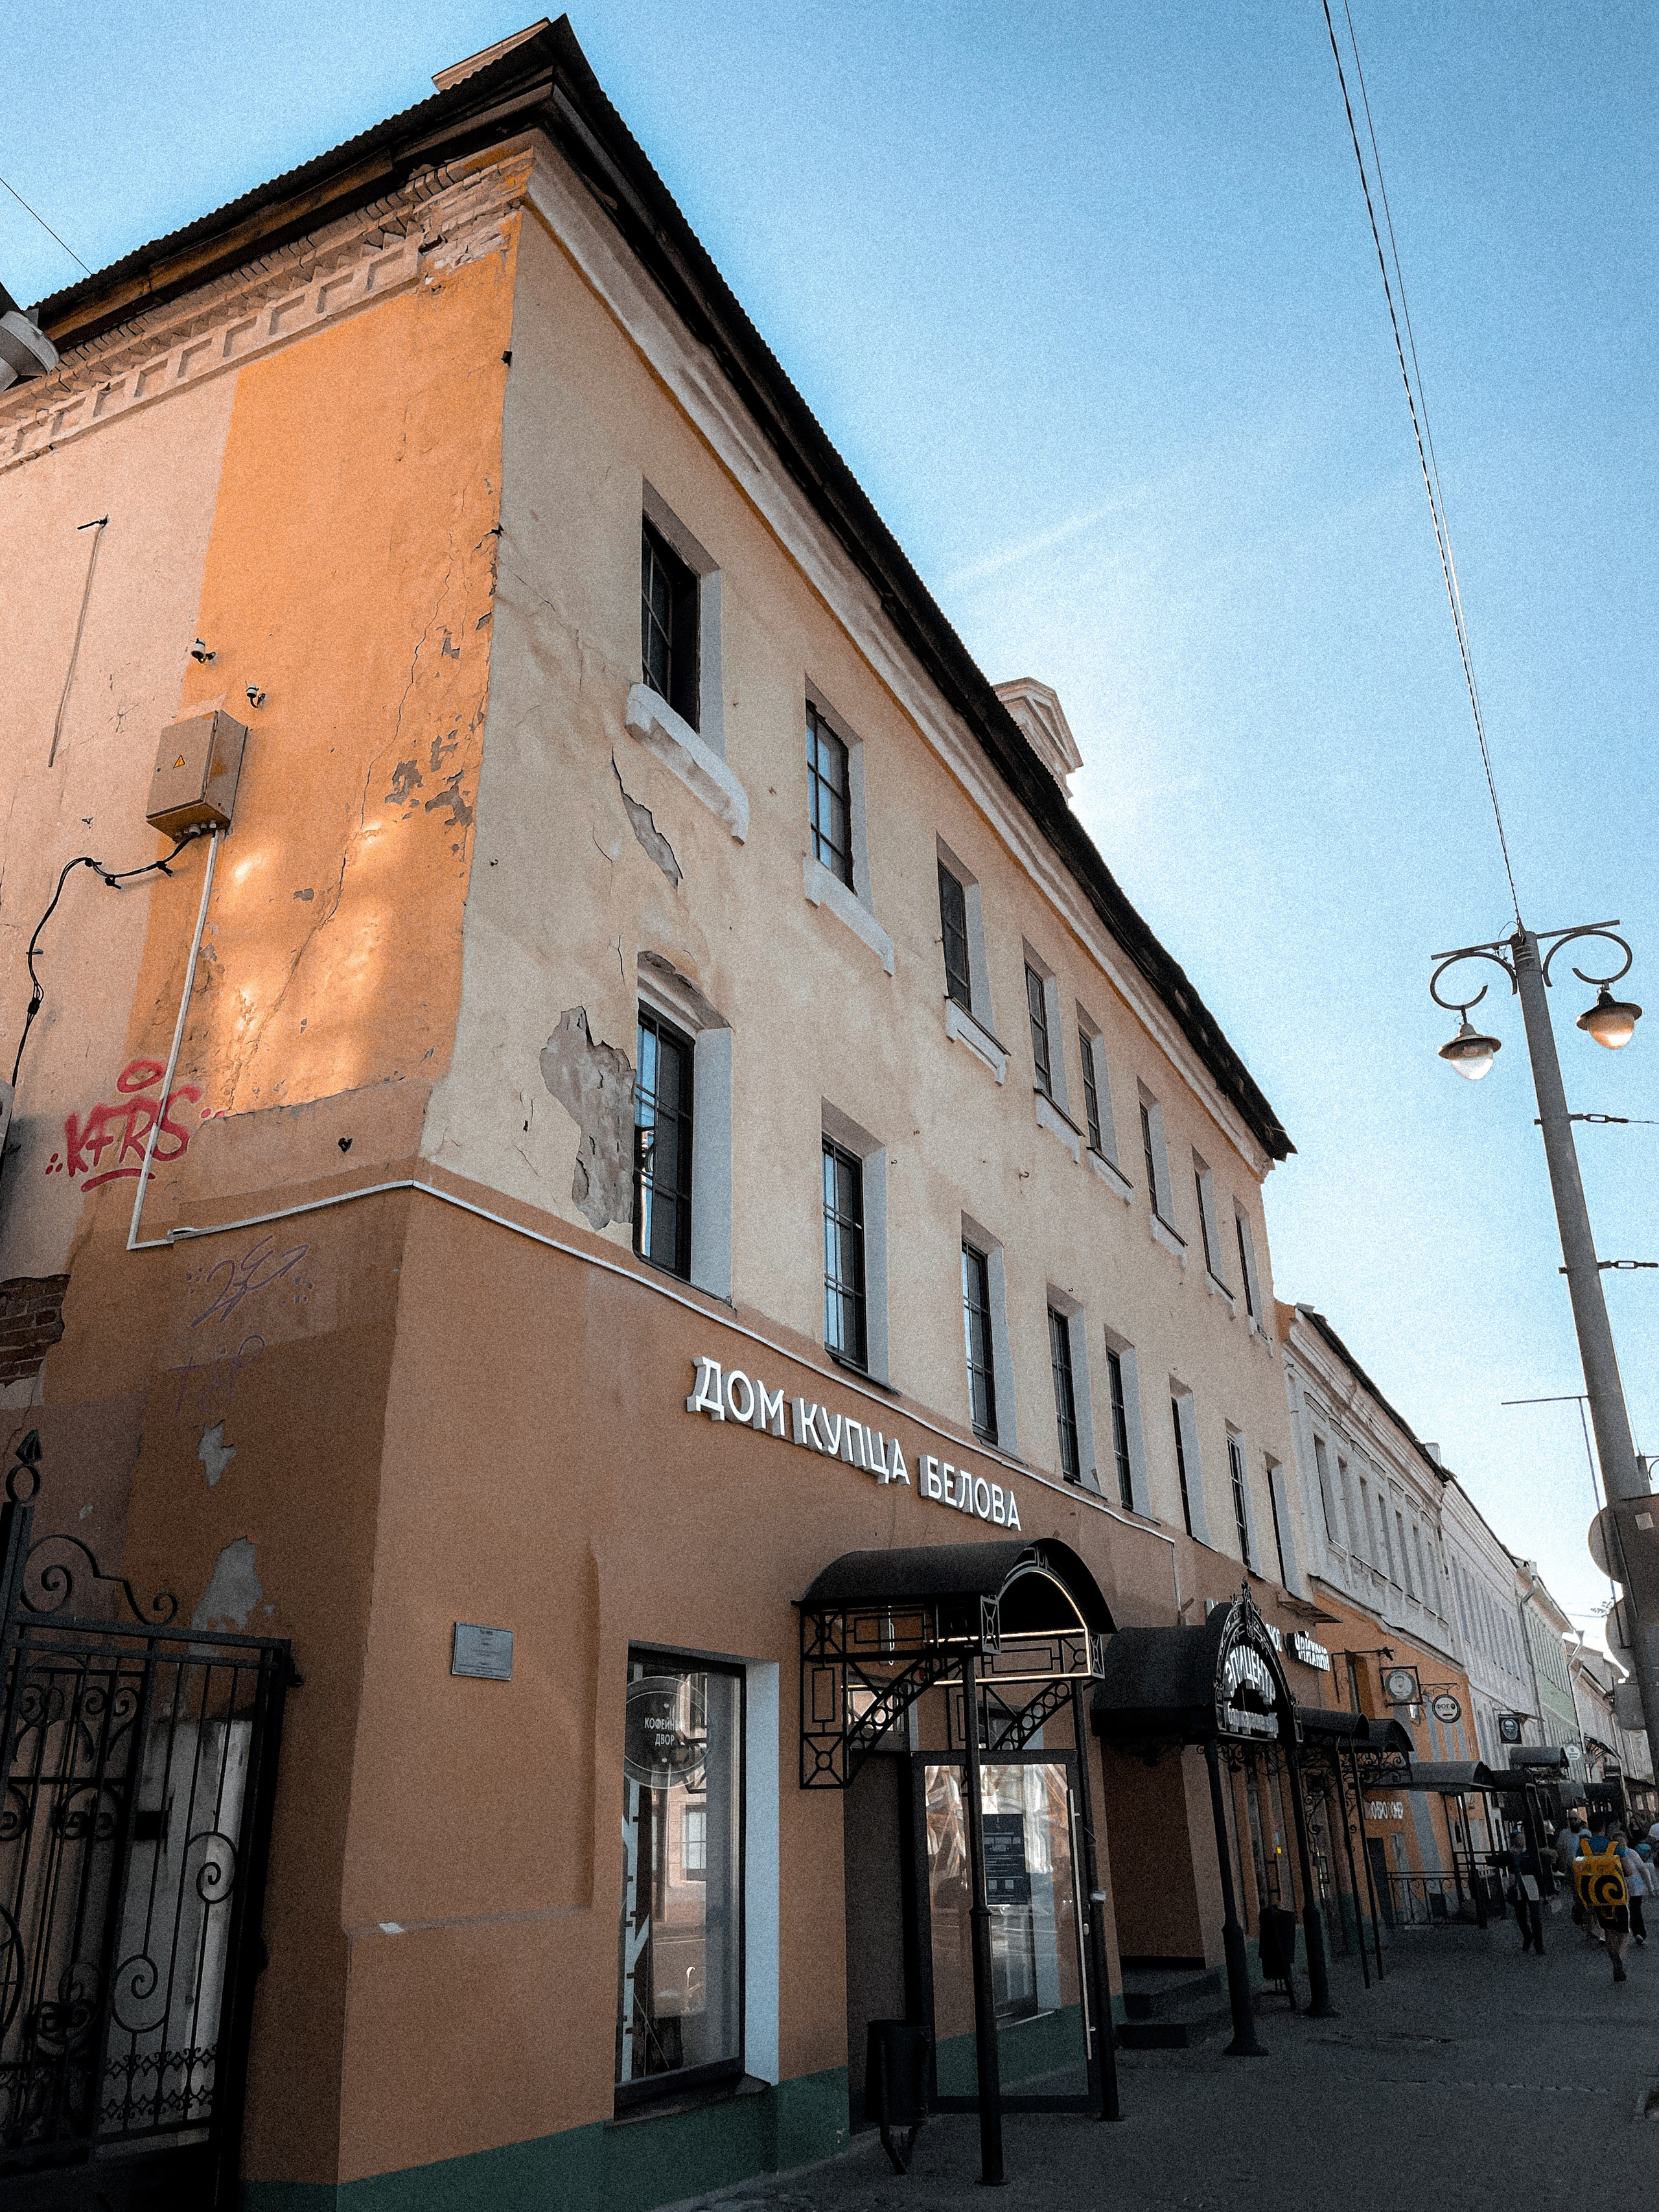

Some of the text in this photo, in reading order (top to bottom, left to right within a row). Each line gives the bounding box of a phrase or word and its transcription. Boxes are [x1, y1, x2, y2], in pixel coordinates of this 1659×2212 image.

[687, 1356, 1021, 1531] ДОМ КУПЦА БЕЛОВА
[1225, 1645, 1276, 1705] ЭПИЦЕНТР
[655, 1733, 675, 1746] ДВОР
